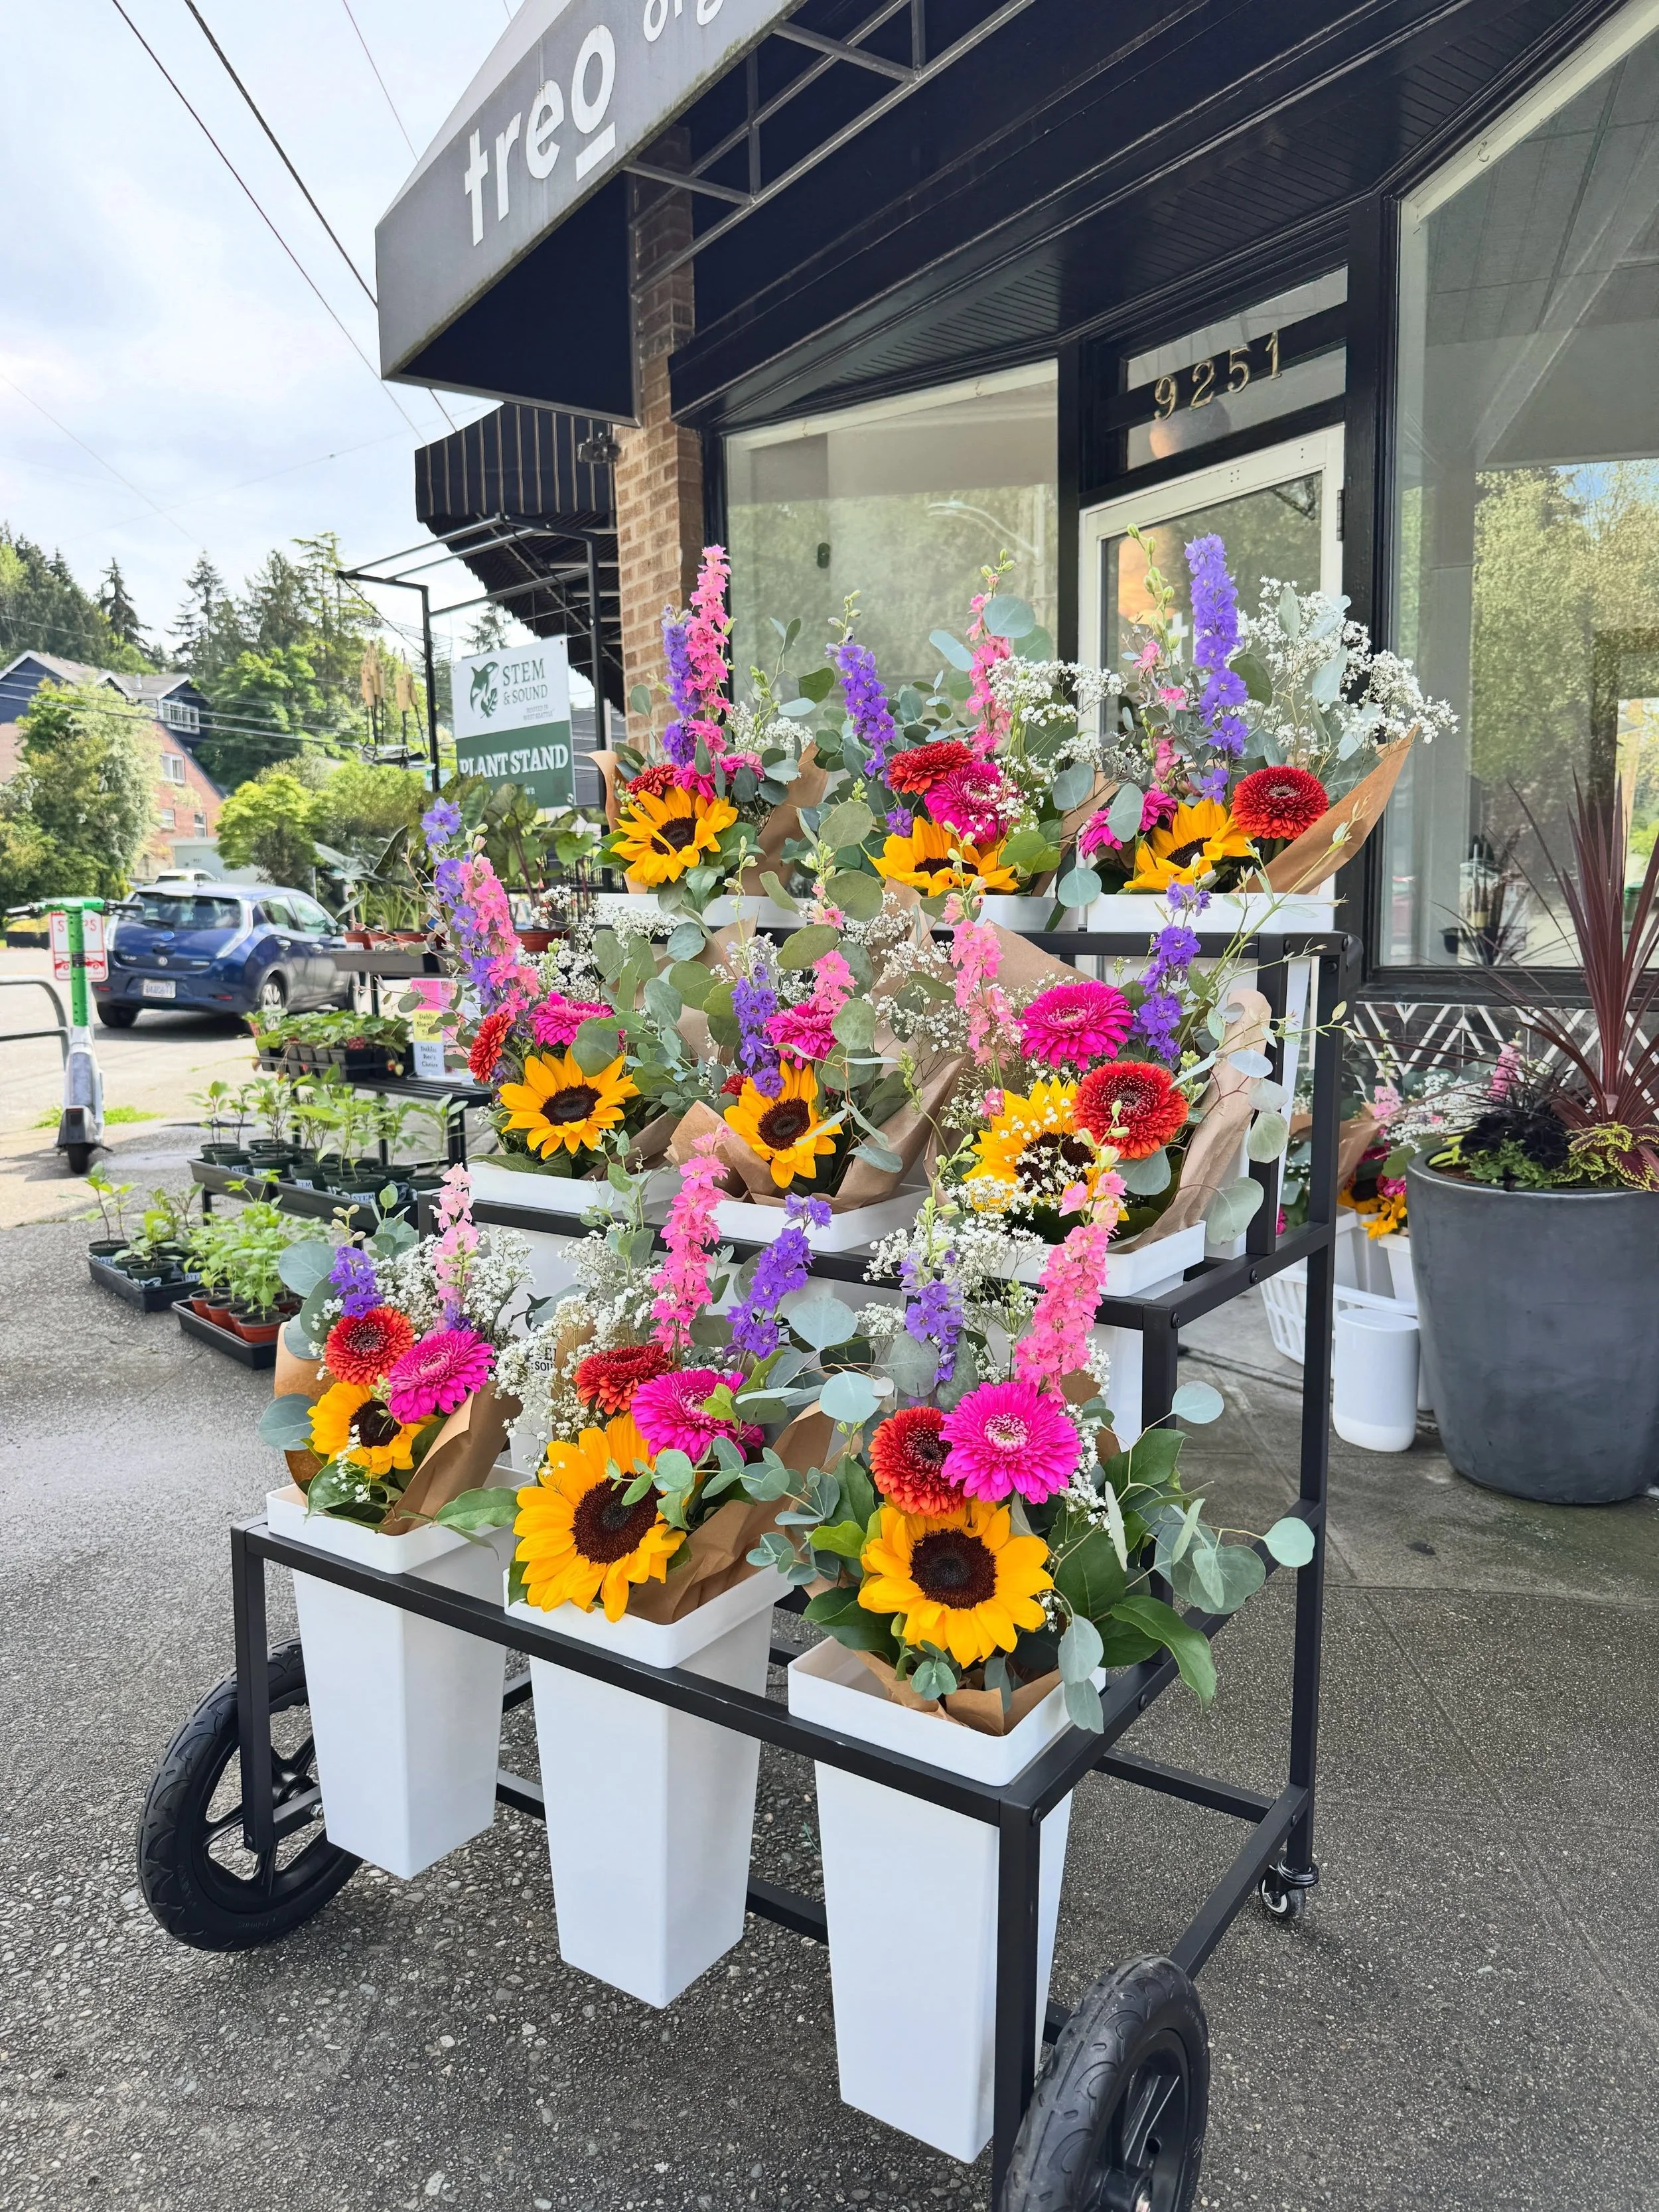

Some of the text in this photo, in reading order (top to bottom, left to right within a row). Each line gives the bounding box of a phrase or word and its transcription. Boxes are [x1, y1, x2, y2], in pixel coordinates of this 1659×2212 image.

[465, 25, 616, 246] treo
[1154, 331, 1282, 421] 9251
[502, 658, 545, 686] STEM
[504, 684, 548, 705] & SOUND
[459, 743, 569, 778] PLANT STAND
